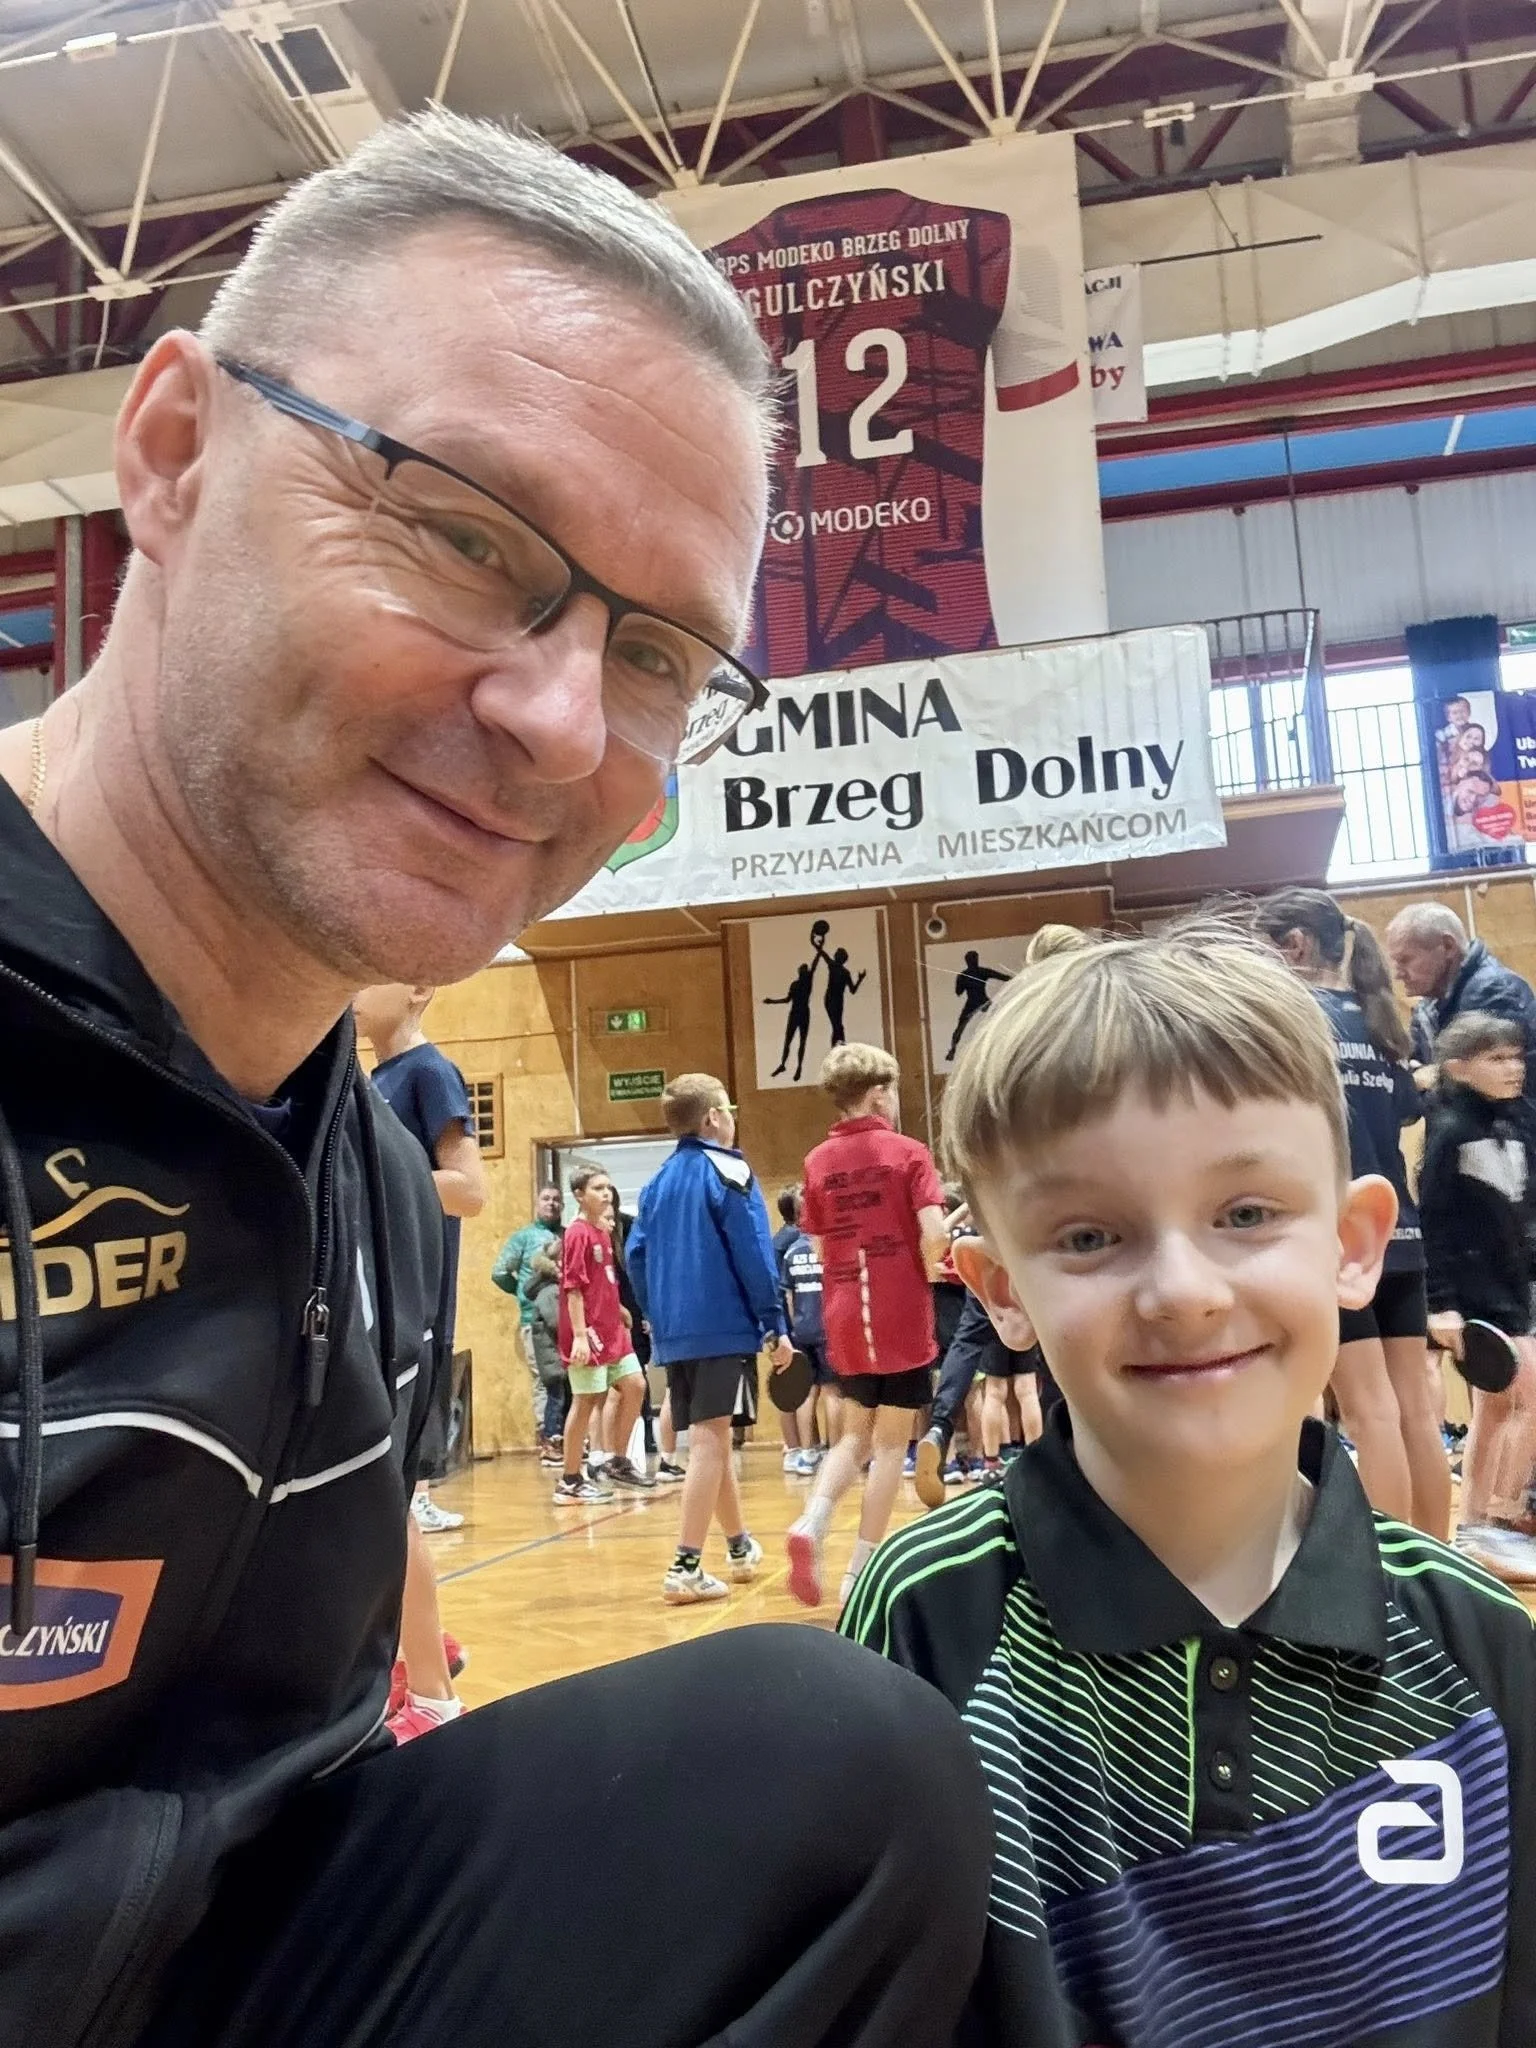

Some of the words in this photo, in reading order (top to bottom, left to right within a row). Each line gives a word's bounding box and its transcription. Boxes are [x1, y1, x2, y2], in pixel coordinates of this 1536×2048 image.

[757, 240, 835, 272] MODEKO
[841, 229, 901, 259] BRZEG
[908, 218, 971, 248] DOLNY
[781, 328, 914, 469] 12
[811, 497, 931, 534] MODEKO
[722, 678, 962, 757] GMINA
[725, 771, 925, 833] Brzeg
[976, 737, 1186, 805] Dolny
[732, 841, 903, 880] PRZYJAZNA
[938, 808, 1187, 859] MIESZKAŃCOM
